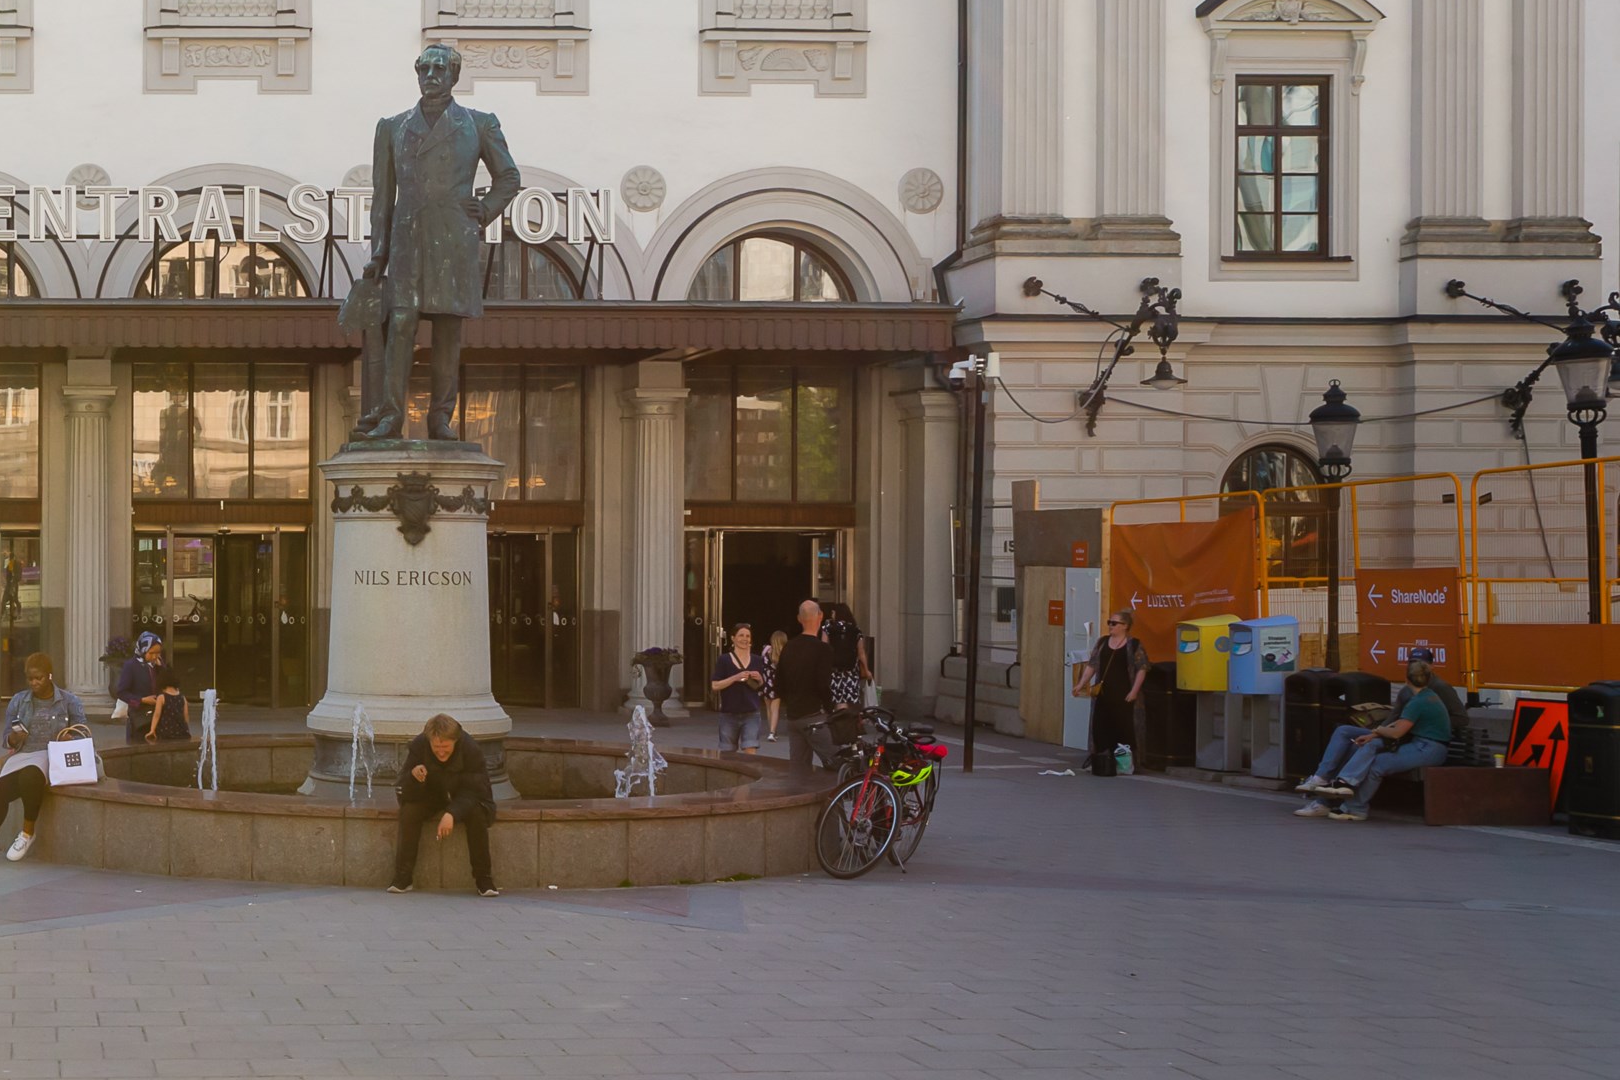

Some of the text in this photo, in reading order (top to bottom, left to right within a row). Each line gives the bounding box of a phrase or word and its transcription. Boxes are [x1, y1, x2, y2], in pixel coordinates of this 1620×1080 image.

[354, 570, 472, 586] NILS ERICSON
[1147, 594, 1185, 607] LUZETTE
